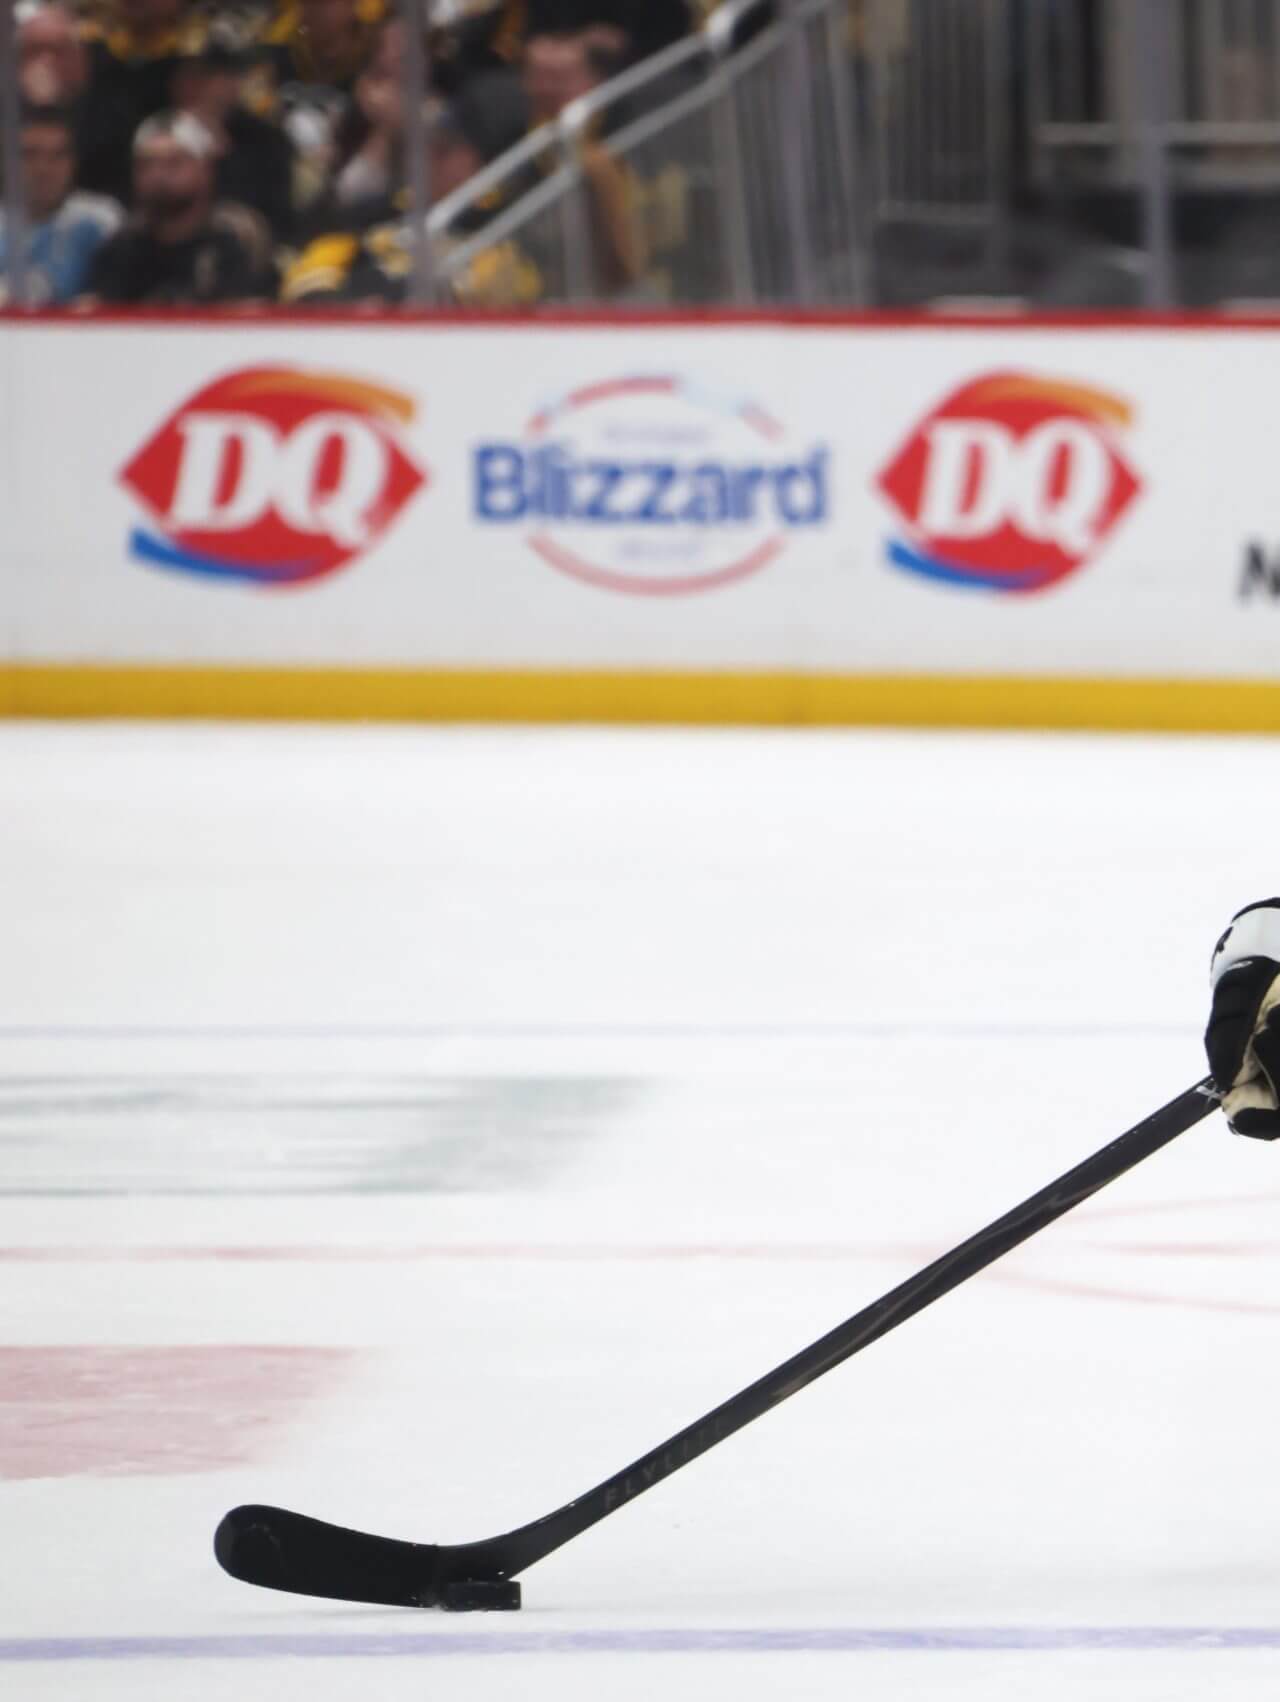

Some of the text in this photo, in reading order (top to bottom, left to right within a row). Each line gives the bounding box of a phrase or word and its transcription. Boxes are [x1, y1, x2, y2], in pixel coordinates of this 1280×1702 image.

[164, 411, 393, 547] DQ
[472, 440, 831, 526] Blizzard
[917, 416, 1115, 553] DQ
